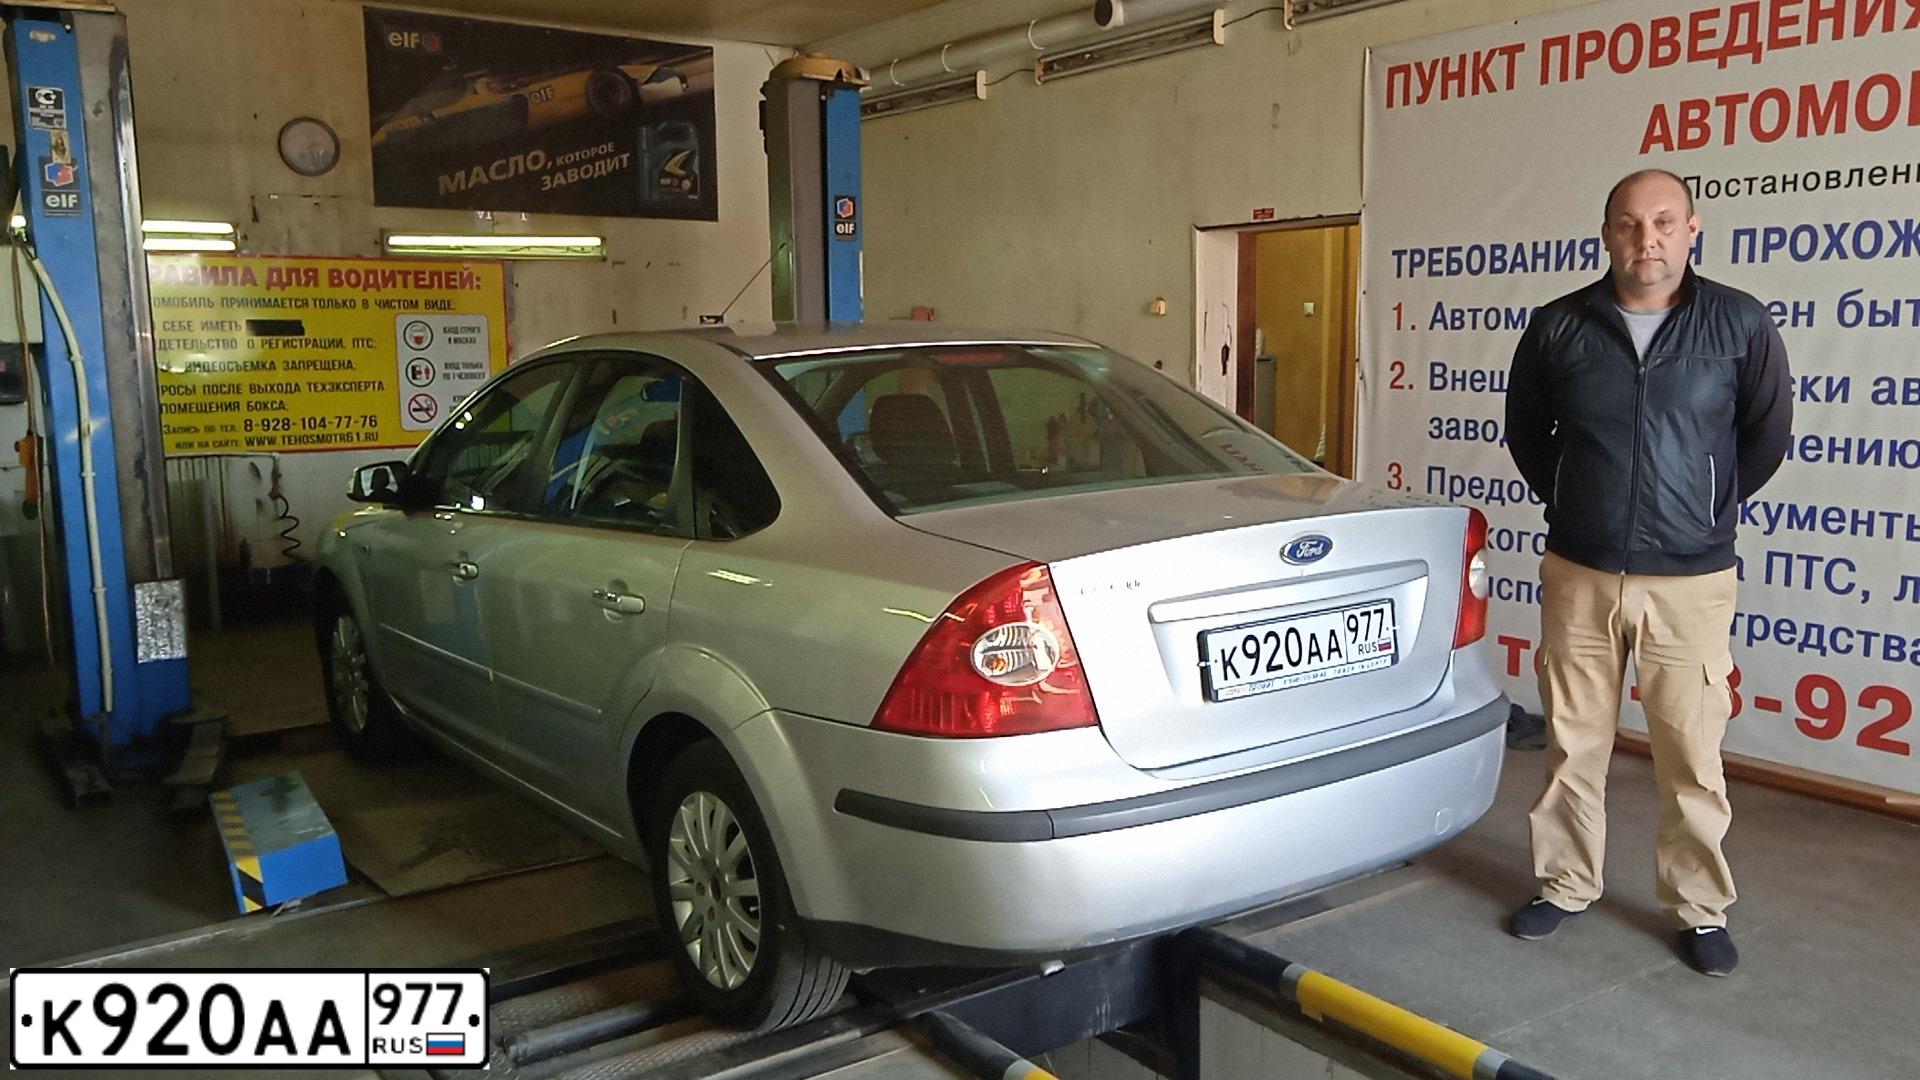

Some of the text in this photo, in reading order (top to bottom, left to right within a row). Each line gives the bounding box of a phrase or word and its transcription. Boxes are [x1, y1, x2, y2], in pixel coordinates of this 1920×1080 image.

[388, 32, 420, 48] elf
[1385, 0, 1920, 109] ПУНКТ ПРОВЕДЕНИ
[531, 87, 554, 103] elf
[1638, 70, 1920, 155] АВТОМО
[437, 142, 616, 196] МАСЛО, КОТОРОЕ
[541, 152, 631, 191] ЗАВОДИТ
[1684, 163, 1920, 200] Постановлен
[46, 194, 79, 209] elf
[836, 223, 855, 235] elf
[1391, 237, 1601, 279] ТРЕБОВАНИЯ
[265, 265, 320, 291] ДЛЯ
[327, 266, 482, 292] ВОДИТЕЛЕЙ:
[220, 296, 309, 310] ПРИНИМАЕТСЯ
[312, 298, 357, 310] ТОЛЬКО
[362, 299, 369, 310] В
[375, 299, 419, 310] ЧИСТОМ
[163, 320, 242, 332] СЕБЕ ИМЕТЬ
[1391, 301, 1417, 331] 1.
[247, 339, 255, 349] О
[184, 360, 277, 374] ВИДЕОСЪЕМКА
[1388, 360, 1414, 390] 2.
[202, 383, 243, 396] ПОСЛЕ
[249, 382, 301, 395] ВЫХОДА
[307, 380, 385, 393] ТЕХЭКСПЕРТА
[160, 403, 241, 415] ПОМЕЩЕНИЯ
[243, 414, 379, 433] 8-928-104-77-76
[1428, 416, 1509, 448] заво
[1386, 461, 1412, 492] 3.
[1296, 540, 1324, 558] Ford
[1764, 550, 1870, 604] ПТС,
[1220, 626, 1343, 681] К920АА
[1347, 607, 1385, 645] 977
[1358, 642, 1378, 656] RUS
